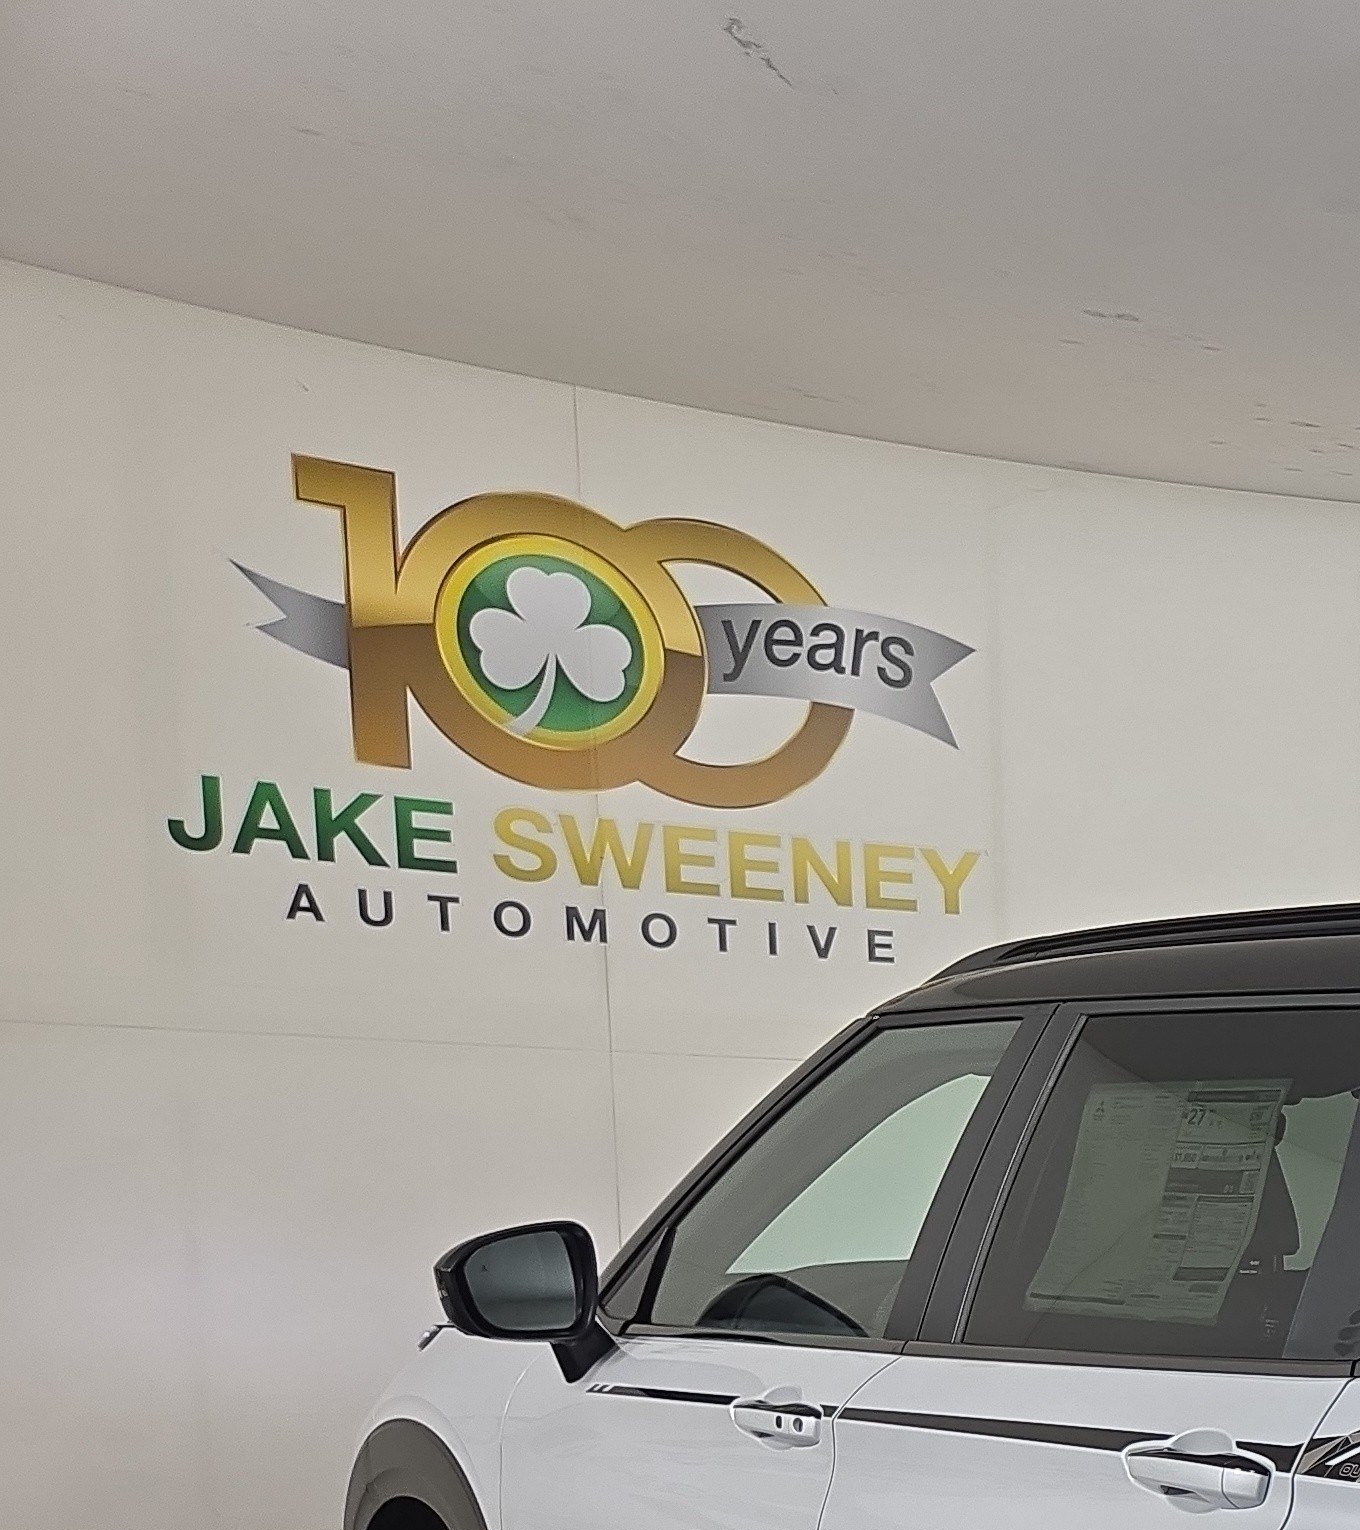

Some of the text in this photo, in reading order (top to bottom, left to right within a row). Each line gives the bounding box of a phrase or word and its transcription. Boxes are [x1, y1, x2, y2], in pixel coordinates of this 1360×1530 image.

[291, 453, 915, 808] 100 years
[168, 775, 978, 916] JAKE SWEENEY
[286, 883, 896, 964] AUTOMOTIVE
